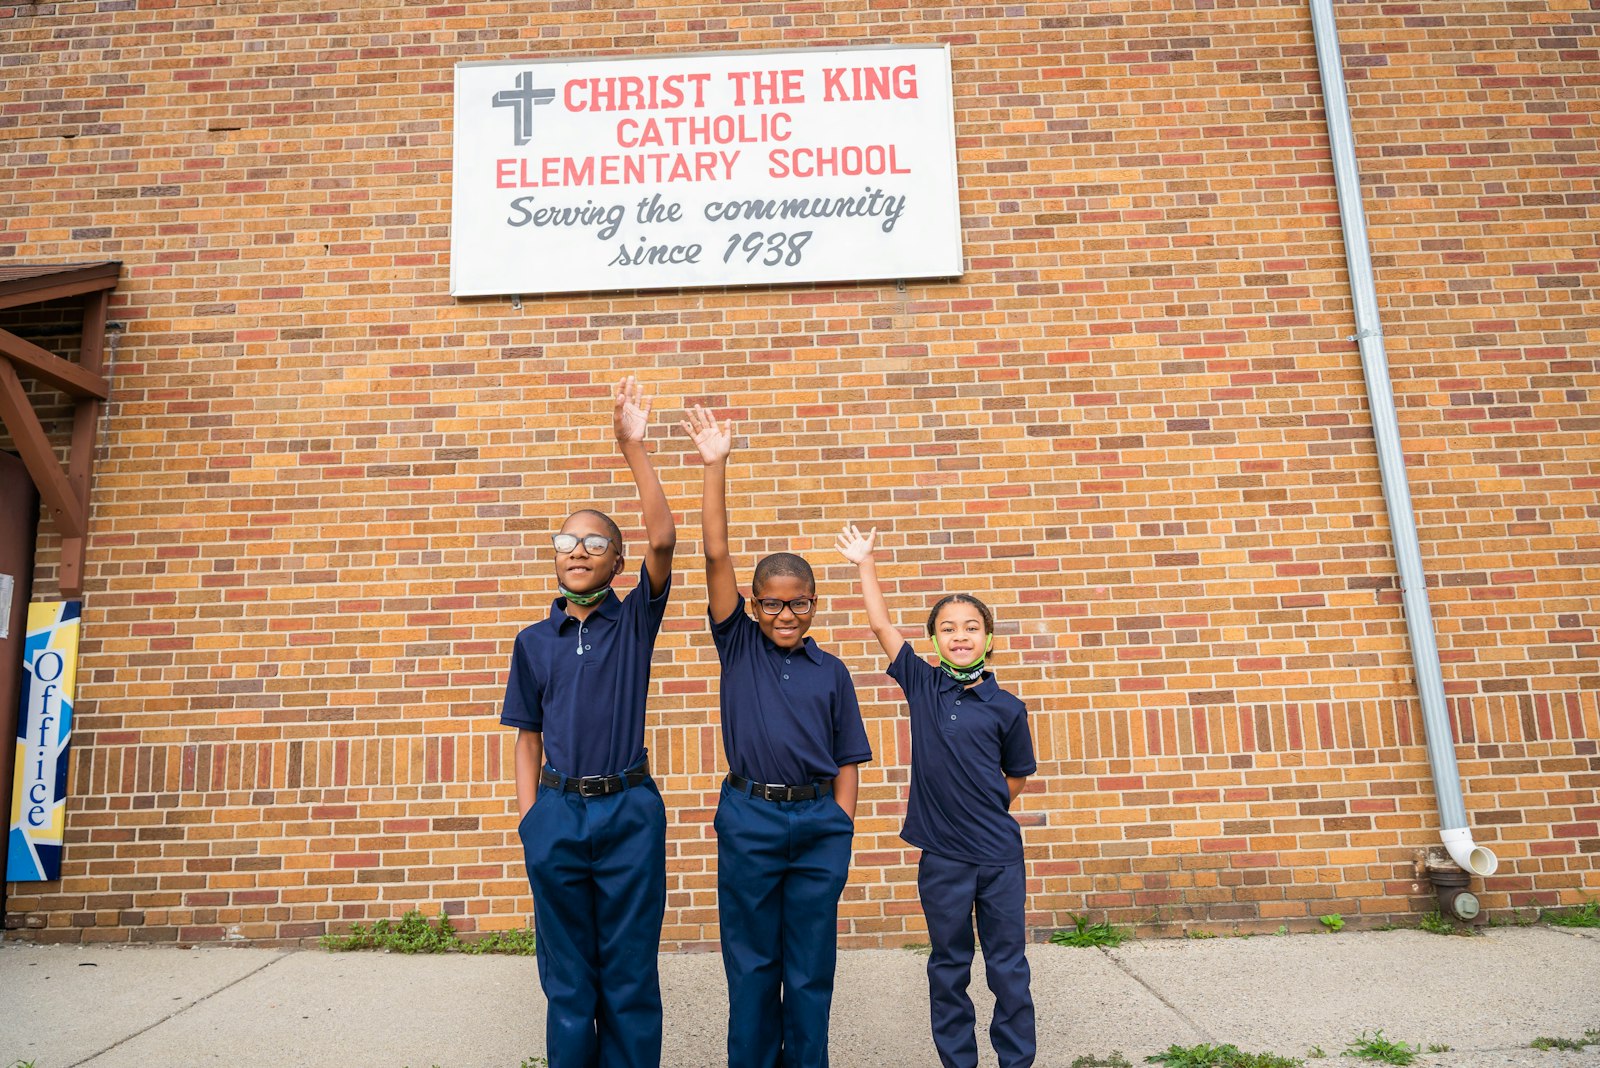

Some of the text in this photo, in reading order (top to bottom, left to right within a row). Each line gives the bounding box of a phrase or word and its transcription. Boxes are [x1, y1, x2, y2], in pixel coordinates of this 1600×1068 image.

[564, 64, 918, 112] CHRIST THE KING
[617, 112, 791, 148] CATHOLIC
[497, 144, 910, 188] ELEMENTARY SCHOOL
[507, 187, 906, 240] Serving the community
[608, 231, 813, 267] since 1938
[28, 652, 63, 827] Office
